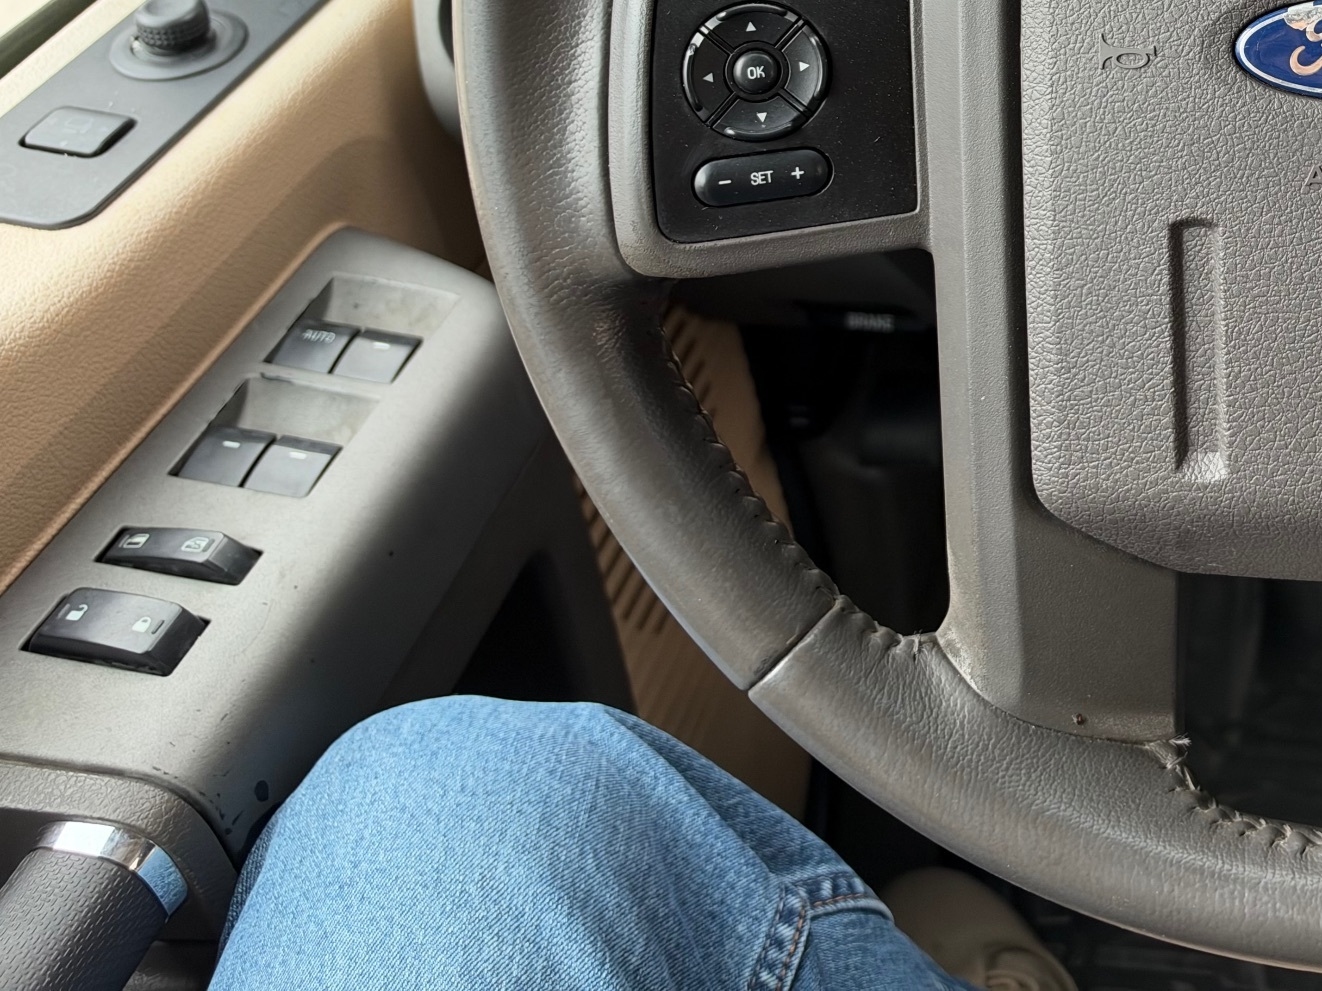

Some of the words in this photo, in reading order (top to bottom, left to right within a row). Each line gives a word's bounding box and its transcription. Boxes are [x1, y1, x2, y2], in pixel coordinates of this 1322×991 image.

[747, 65, 766, 80] OK
[750, 170, 774, 186] SET
[302, 328, 336, 344] AUTO
